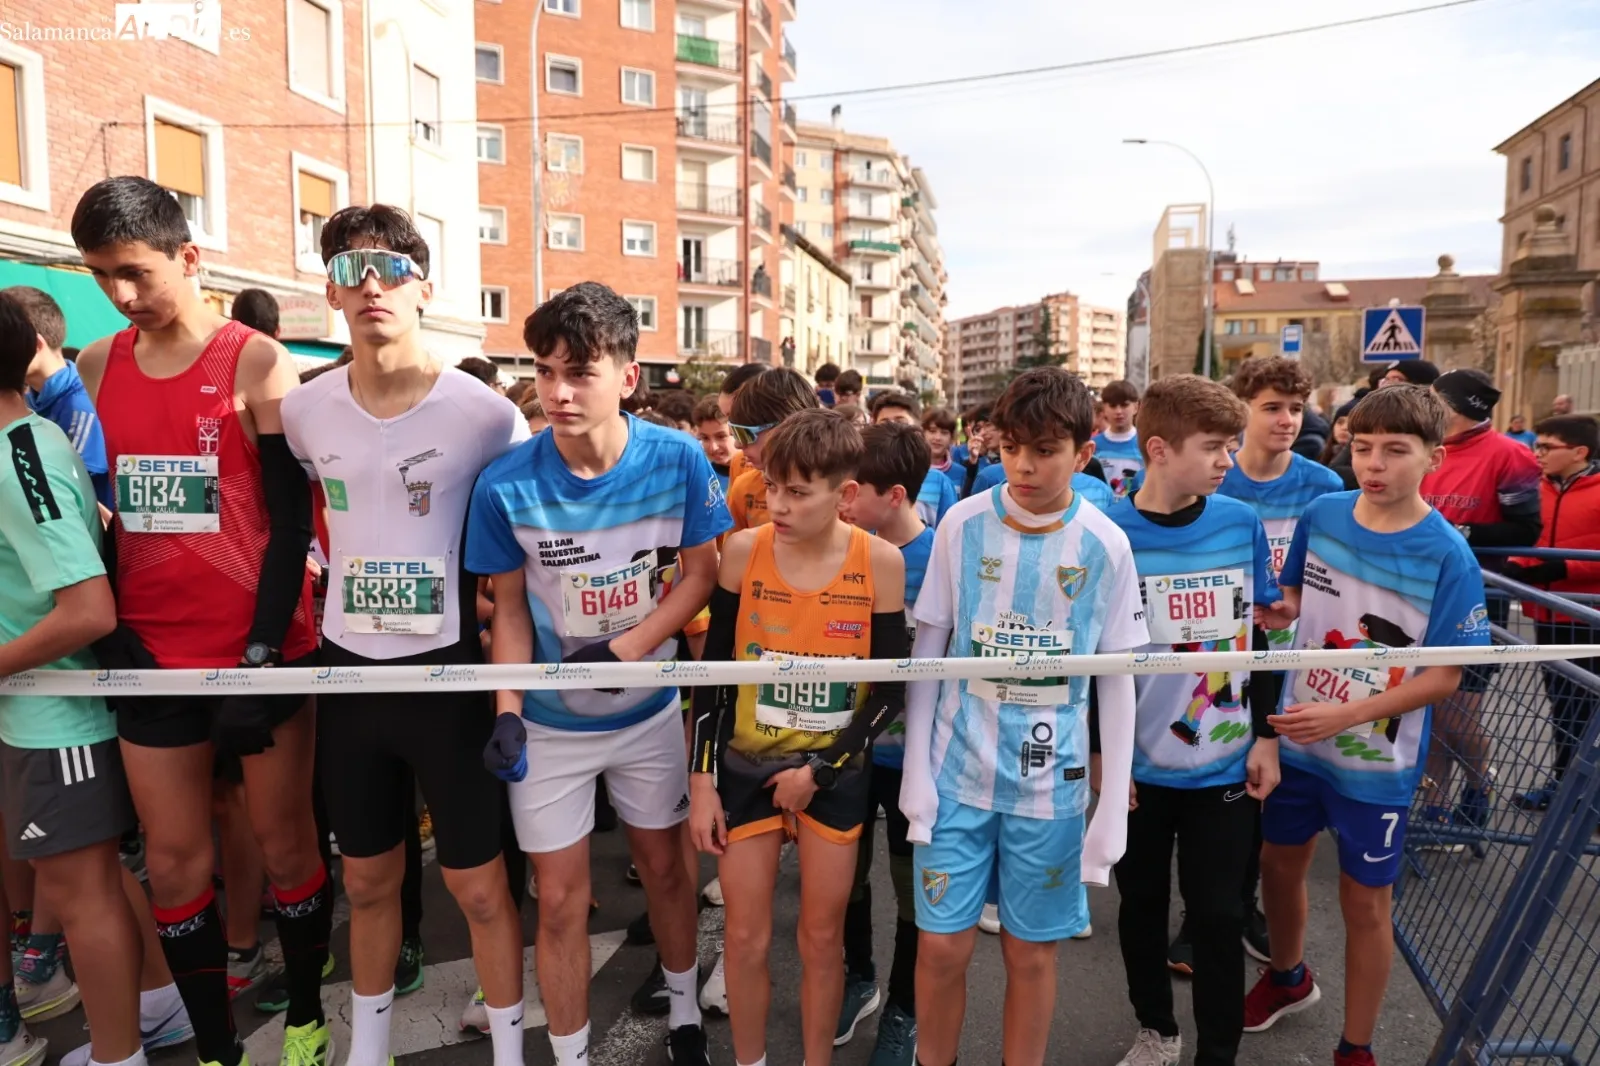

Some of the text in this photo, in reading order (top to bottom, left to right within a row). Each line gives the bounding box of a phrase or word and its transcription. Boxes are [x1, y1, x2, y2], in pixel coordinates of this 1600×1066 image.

[138, 459, 207, 473] SETEL
[128, 476, 187, 507] 6134
[537, 537, 574, 549] XLI SAN
[1268, 537, 1293, 546] TEL
[539, 546, 586, 559] SILVESTRE
[540, 552, 601, 567] SALMANTINA
[364, 561, 434, 575] SETEL
[590, 561, 652, 588] SETEL
[1172, 574, 1235, 590] SETEL
[352, 578, 417, 609] 6333
[581, 579, 639, 616] 6148
[1168, 591, 1217, 621] 6181
[999, 610, 1028, 624] sabor
[994, 631, 1063, 648] SETEL
[1306, 668, 1350, 704] 6214
[773, 681, 831, 708] 6199
[788, 704, 814, 713] DAMASO
[1380, 812, 1400, 849] 7
